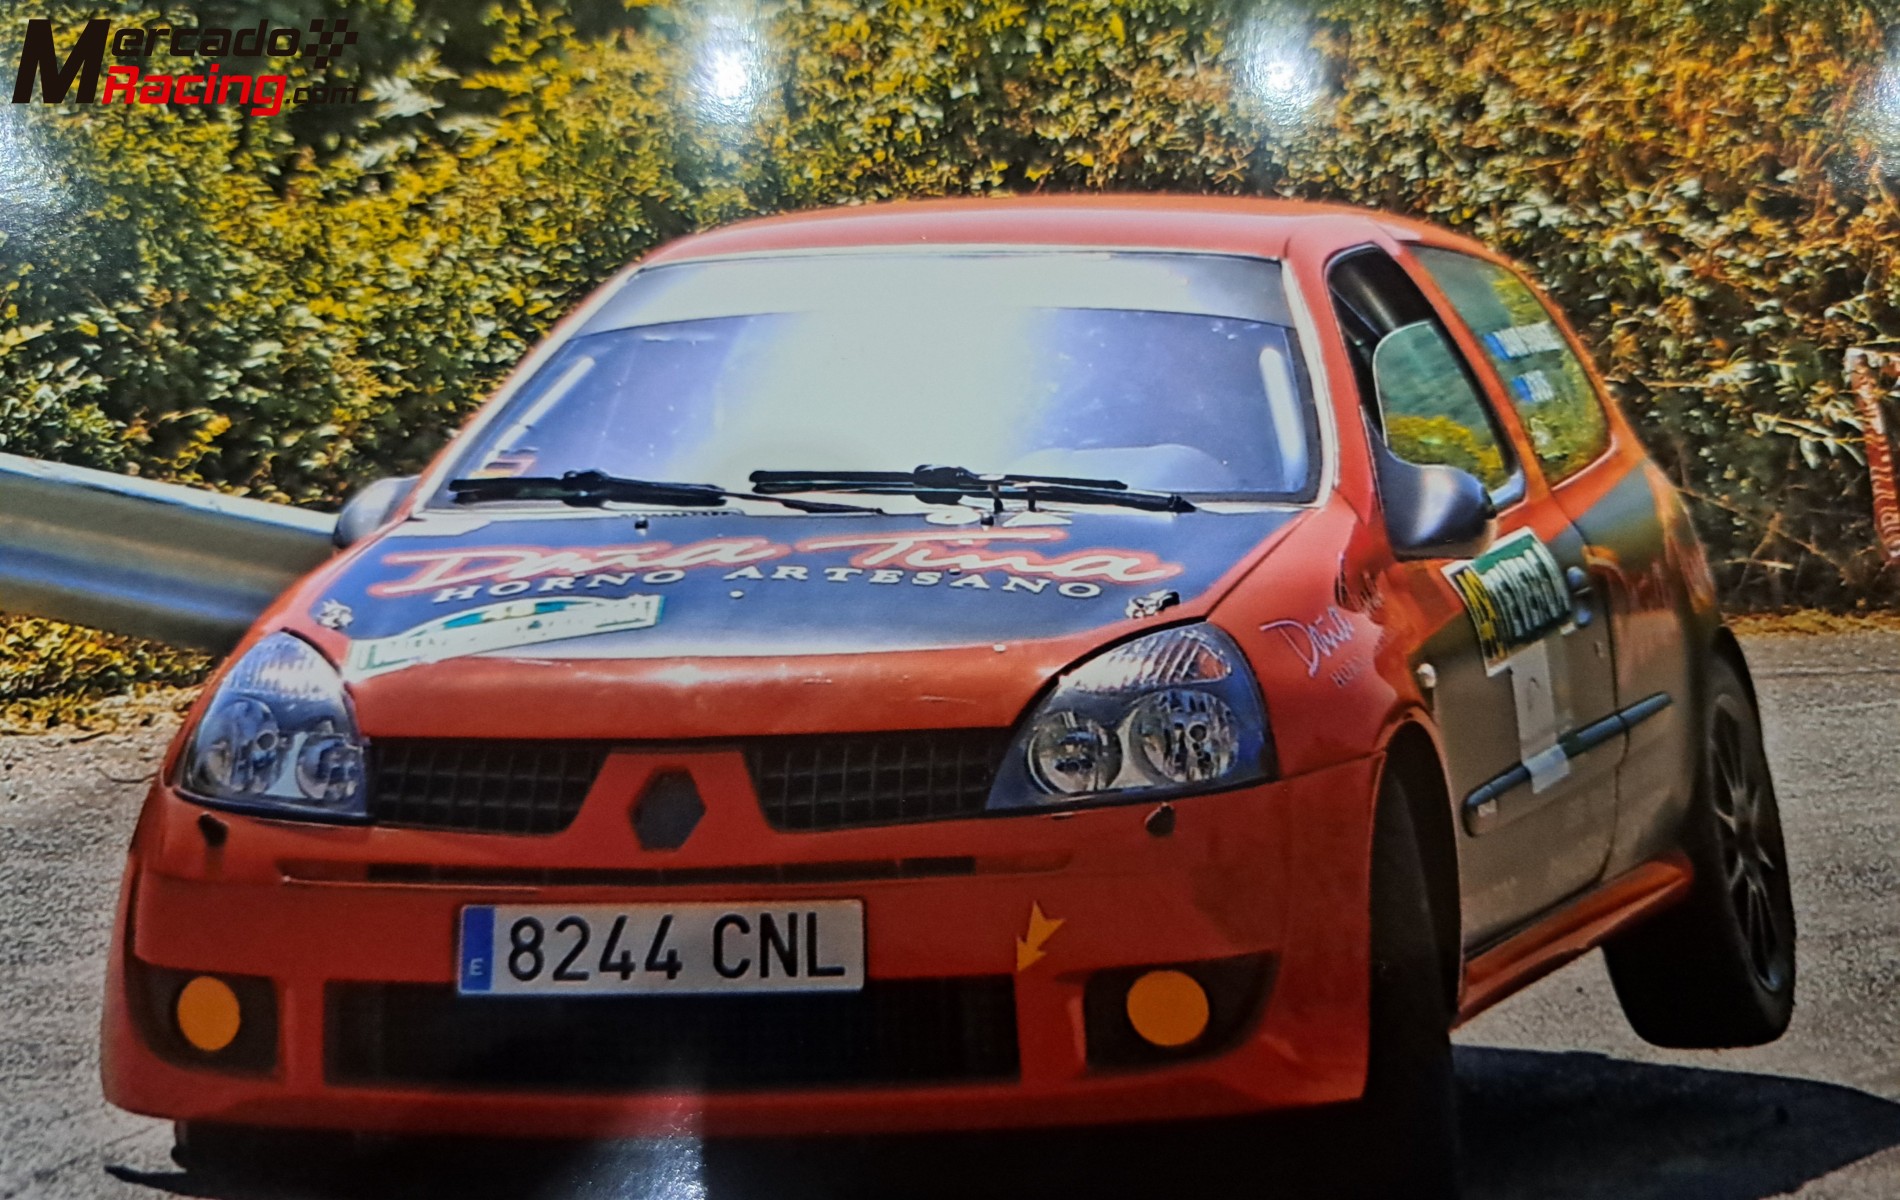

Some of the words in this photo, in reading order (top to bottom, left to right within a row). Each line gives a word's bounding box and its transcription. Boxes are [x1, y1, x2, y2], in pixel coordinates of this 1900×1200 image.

[795, 527, 1184, 585] Tina
[433, 568, 686, 604] HORNO
[723, 565, 1102, 599] ARTESANO
[468, 957, 484, 977] E
[507, 914, 683, 982] 8244
[712, 911, 846, 980] CNL
